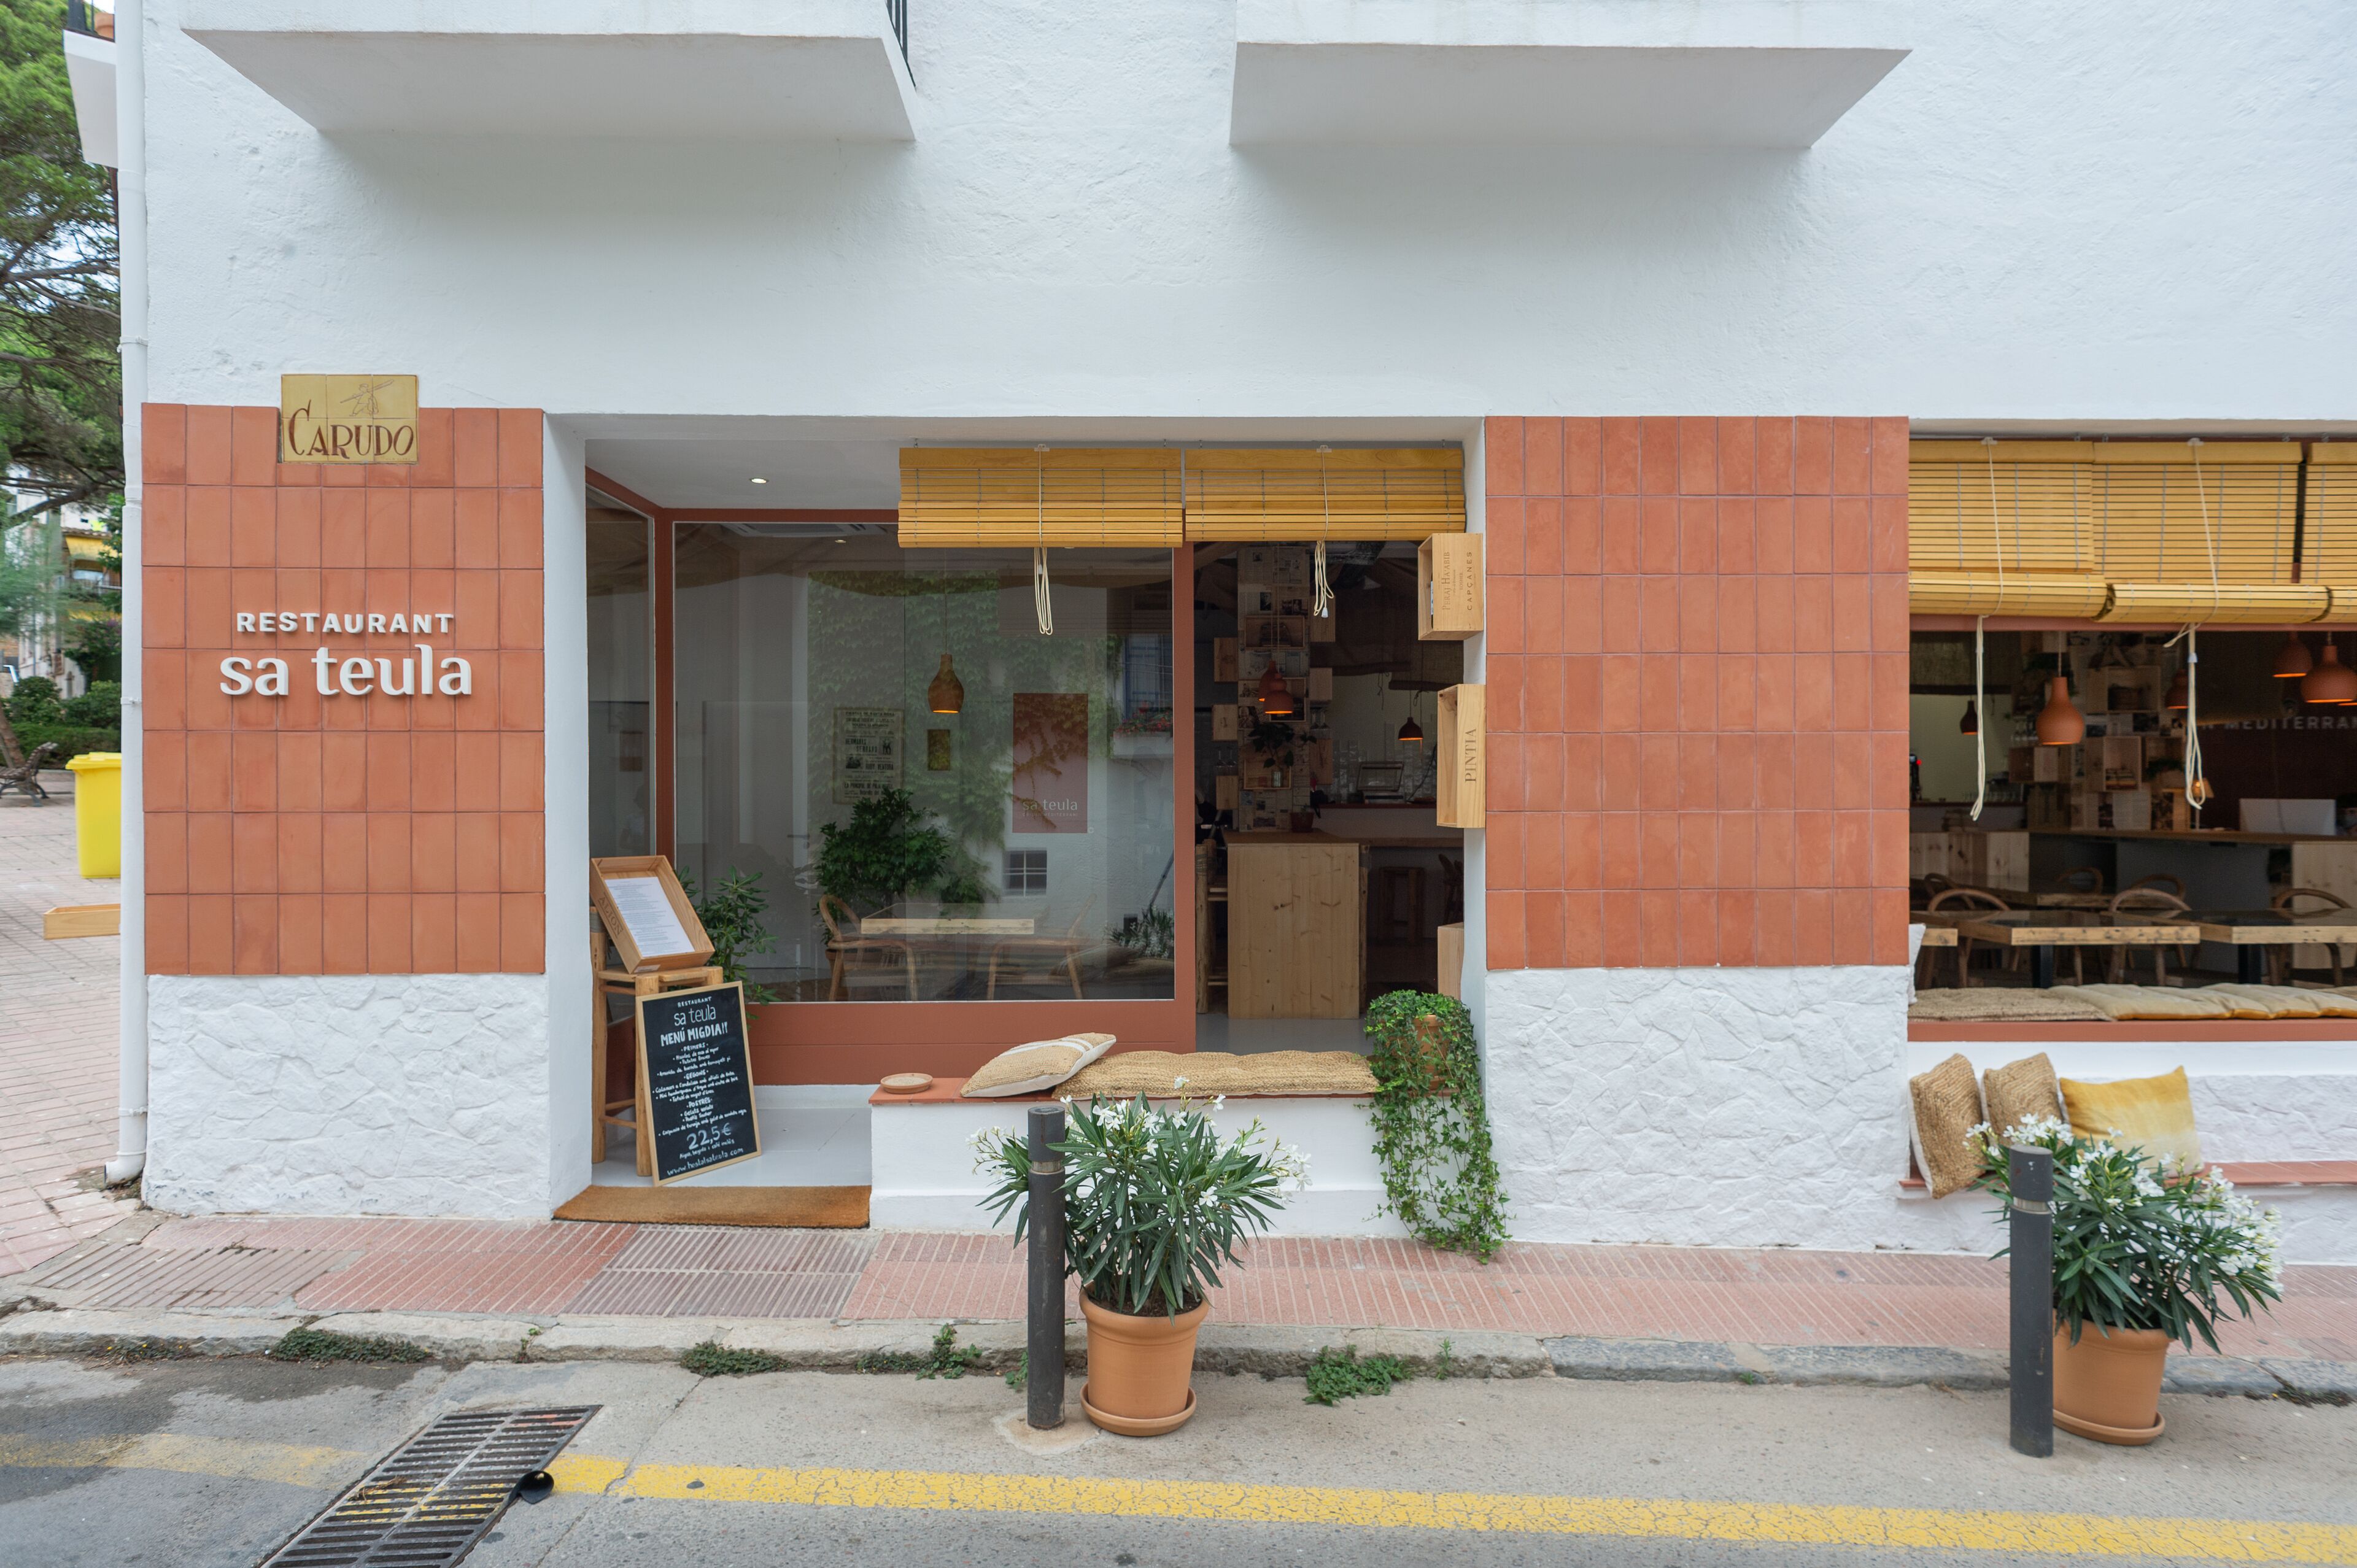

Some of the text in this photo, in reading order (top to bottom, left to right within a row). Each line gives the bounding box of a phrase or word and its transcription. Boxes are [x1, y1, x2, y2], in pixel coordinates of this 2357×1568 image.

[288, 400, 414, 459] CARUDO
[236, 612, 454, 634] RESTAURANT
[220, 644, 472, 697] sa teula
[1465, 728, 1476, 782] PINTIA
[1023, 798, 1078, 811] sa teula
[677, 996, 712, 1008] RESTAURANT
[674, 1004, 716, 1026] sa teula
[660, 1027, 686, 1046] MENÚ
[683, 1042, 706, 1052] PRIMERS
[688, 1097, 711, 1108] POSTRES
